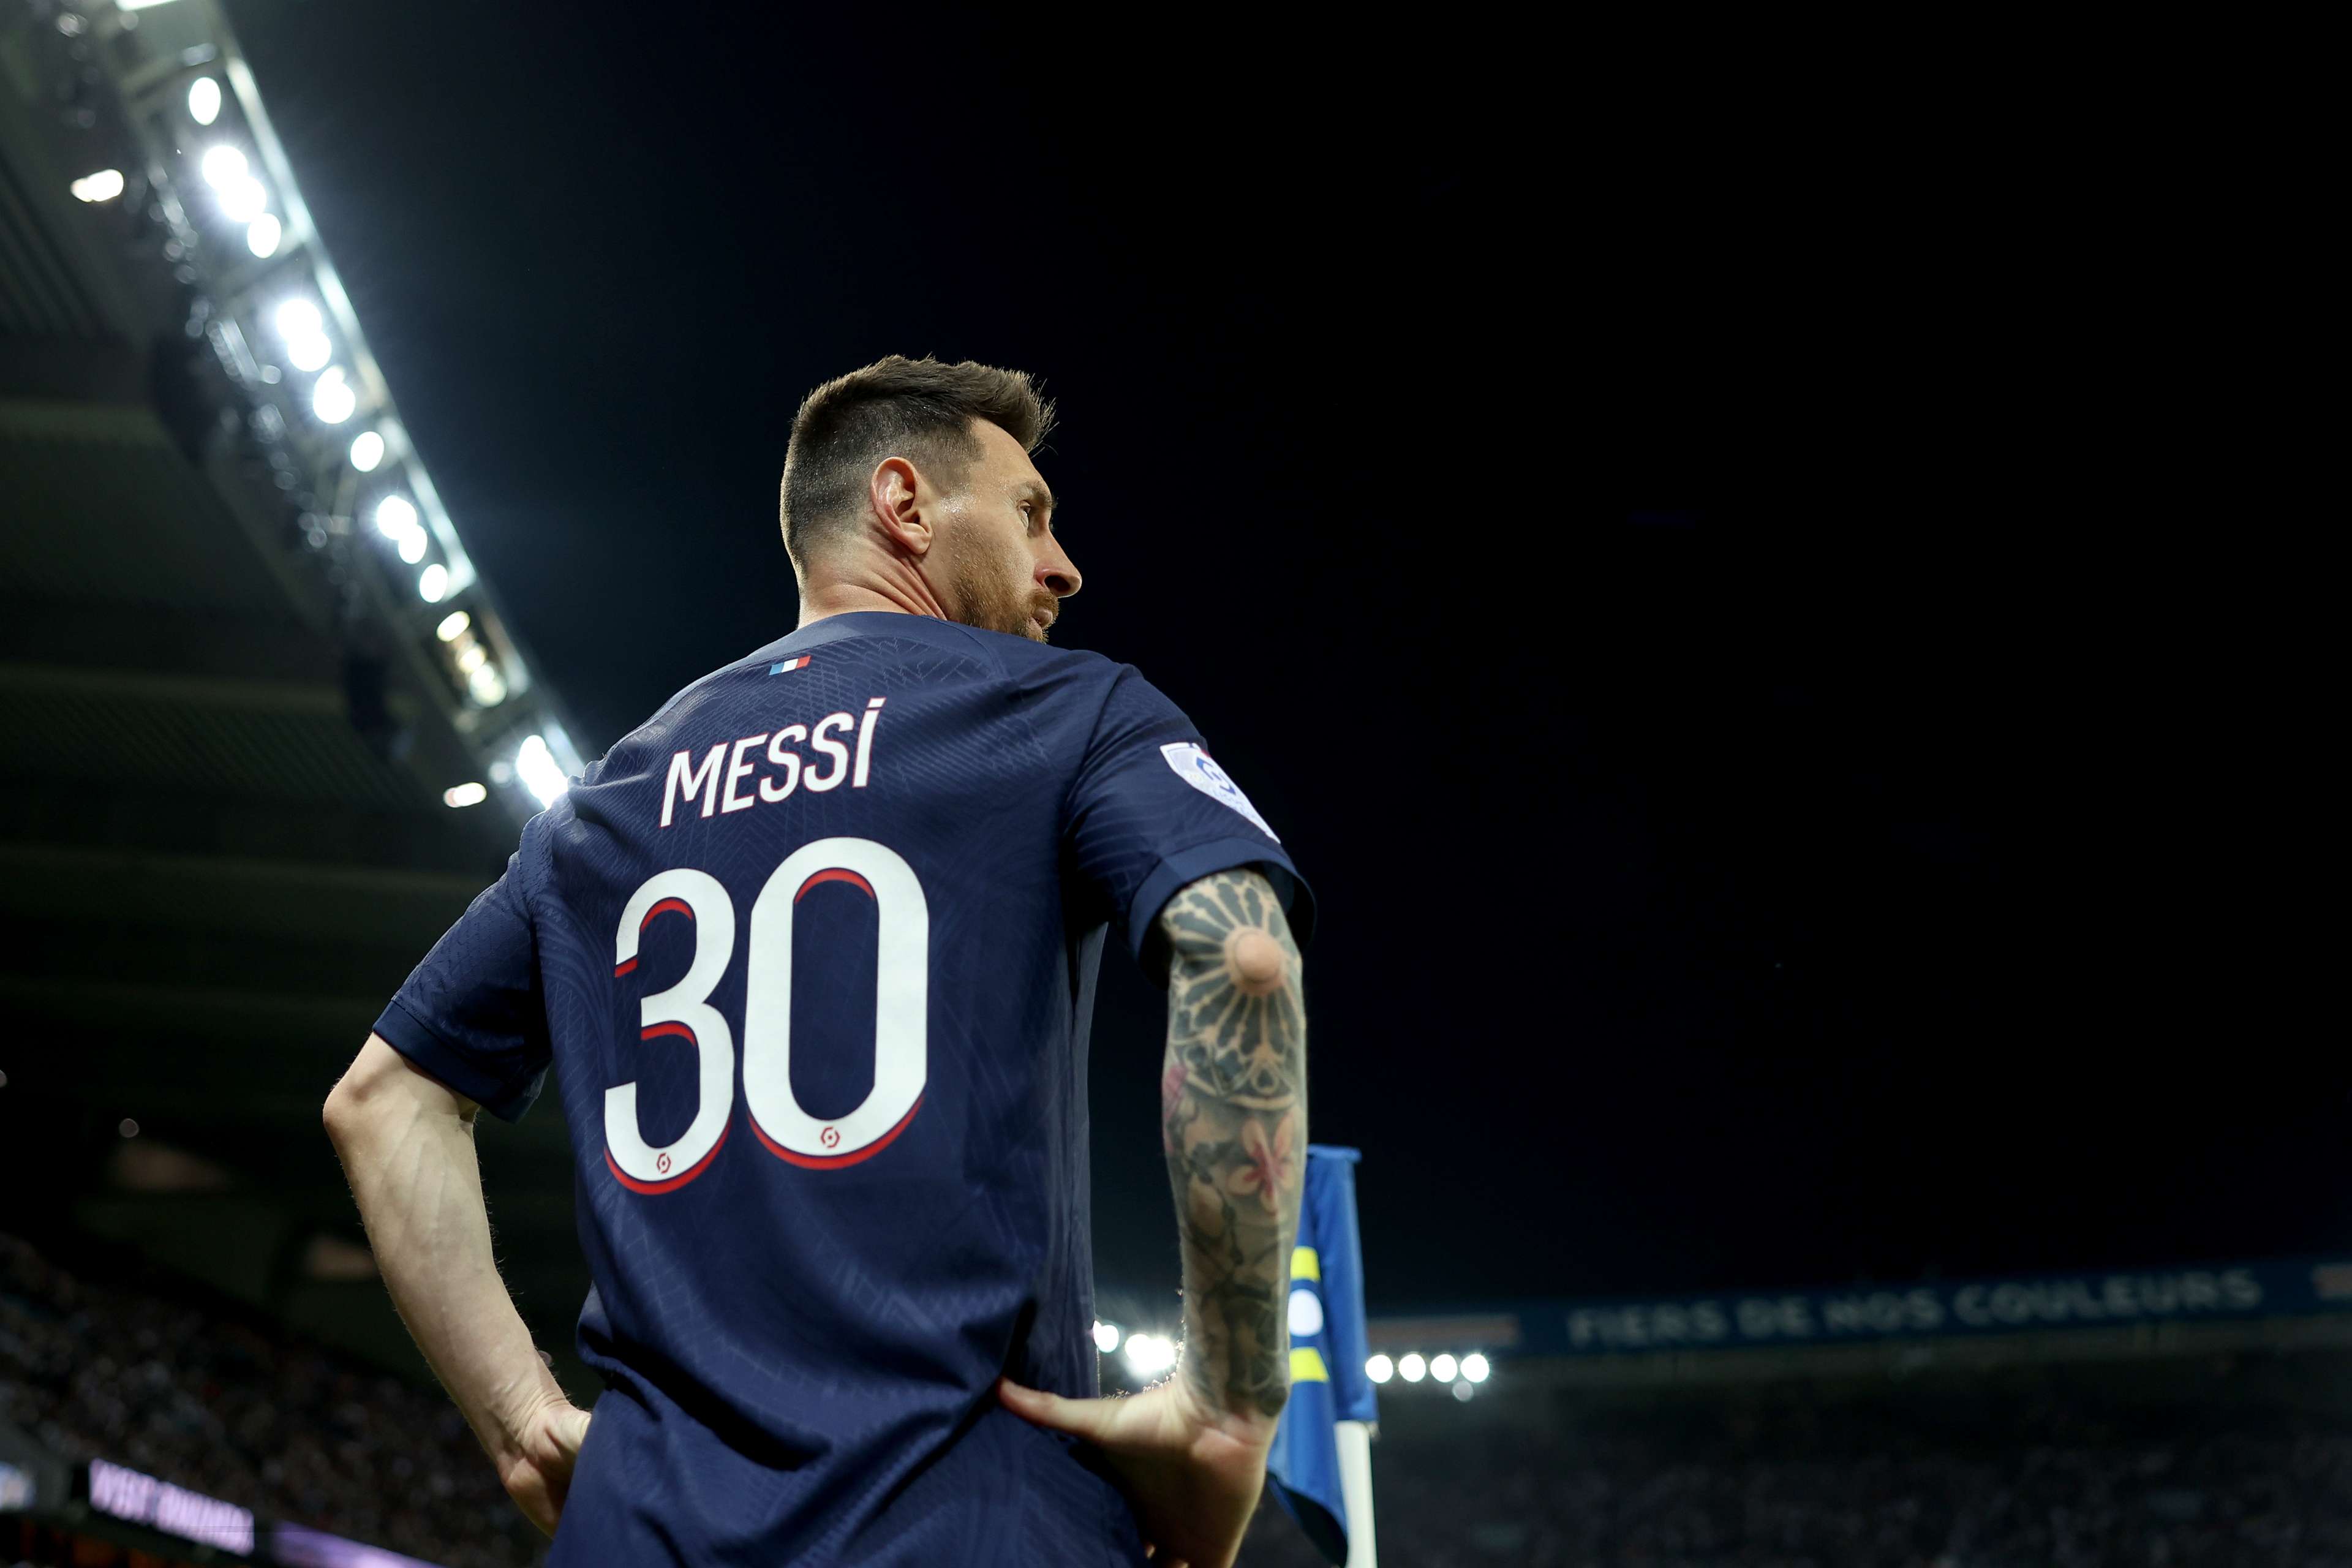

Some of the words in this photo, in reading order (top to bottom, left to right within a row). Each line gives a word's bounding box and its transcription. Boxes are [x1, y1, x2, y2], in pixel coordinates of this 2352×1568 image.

[659, 697, 887, 828] MESSI
[605, 837, 929, 1195] 30
[1736, 1294, 1813, 1338] DE
[1823, 1287, 1945, 1332] NOS
[1954, 1269, 2262, 1324] COULEURS
